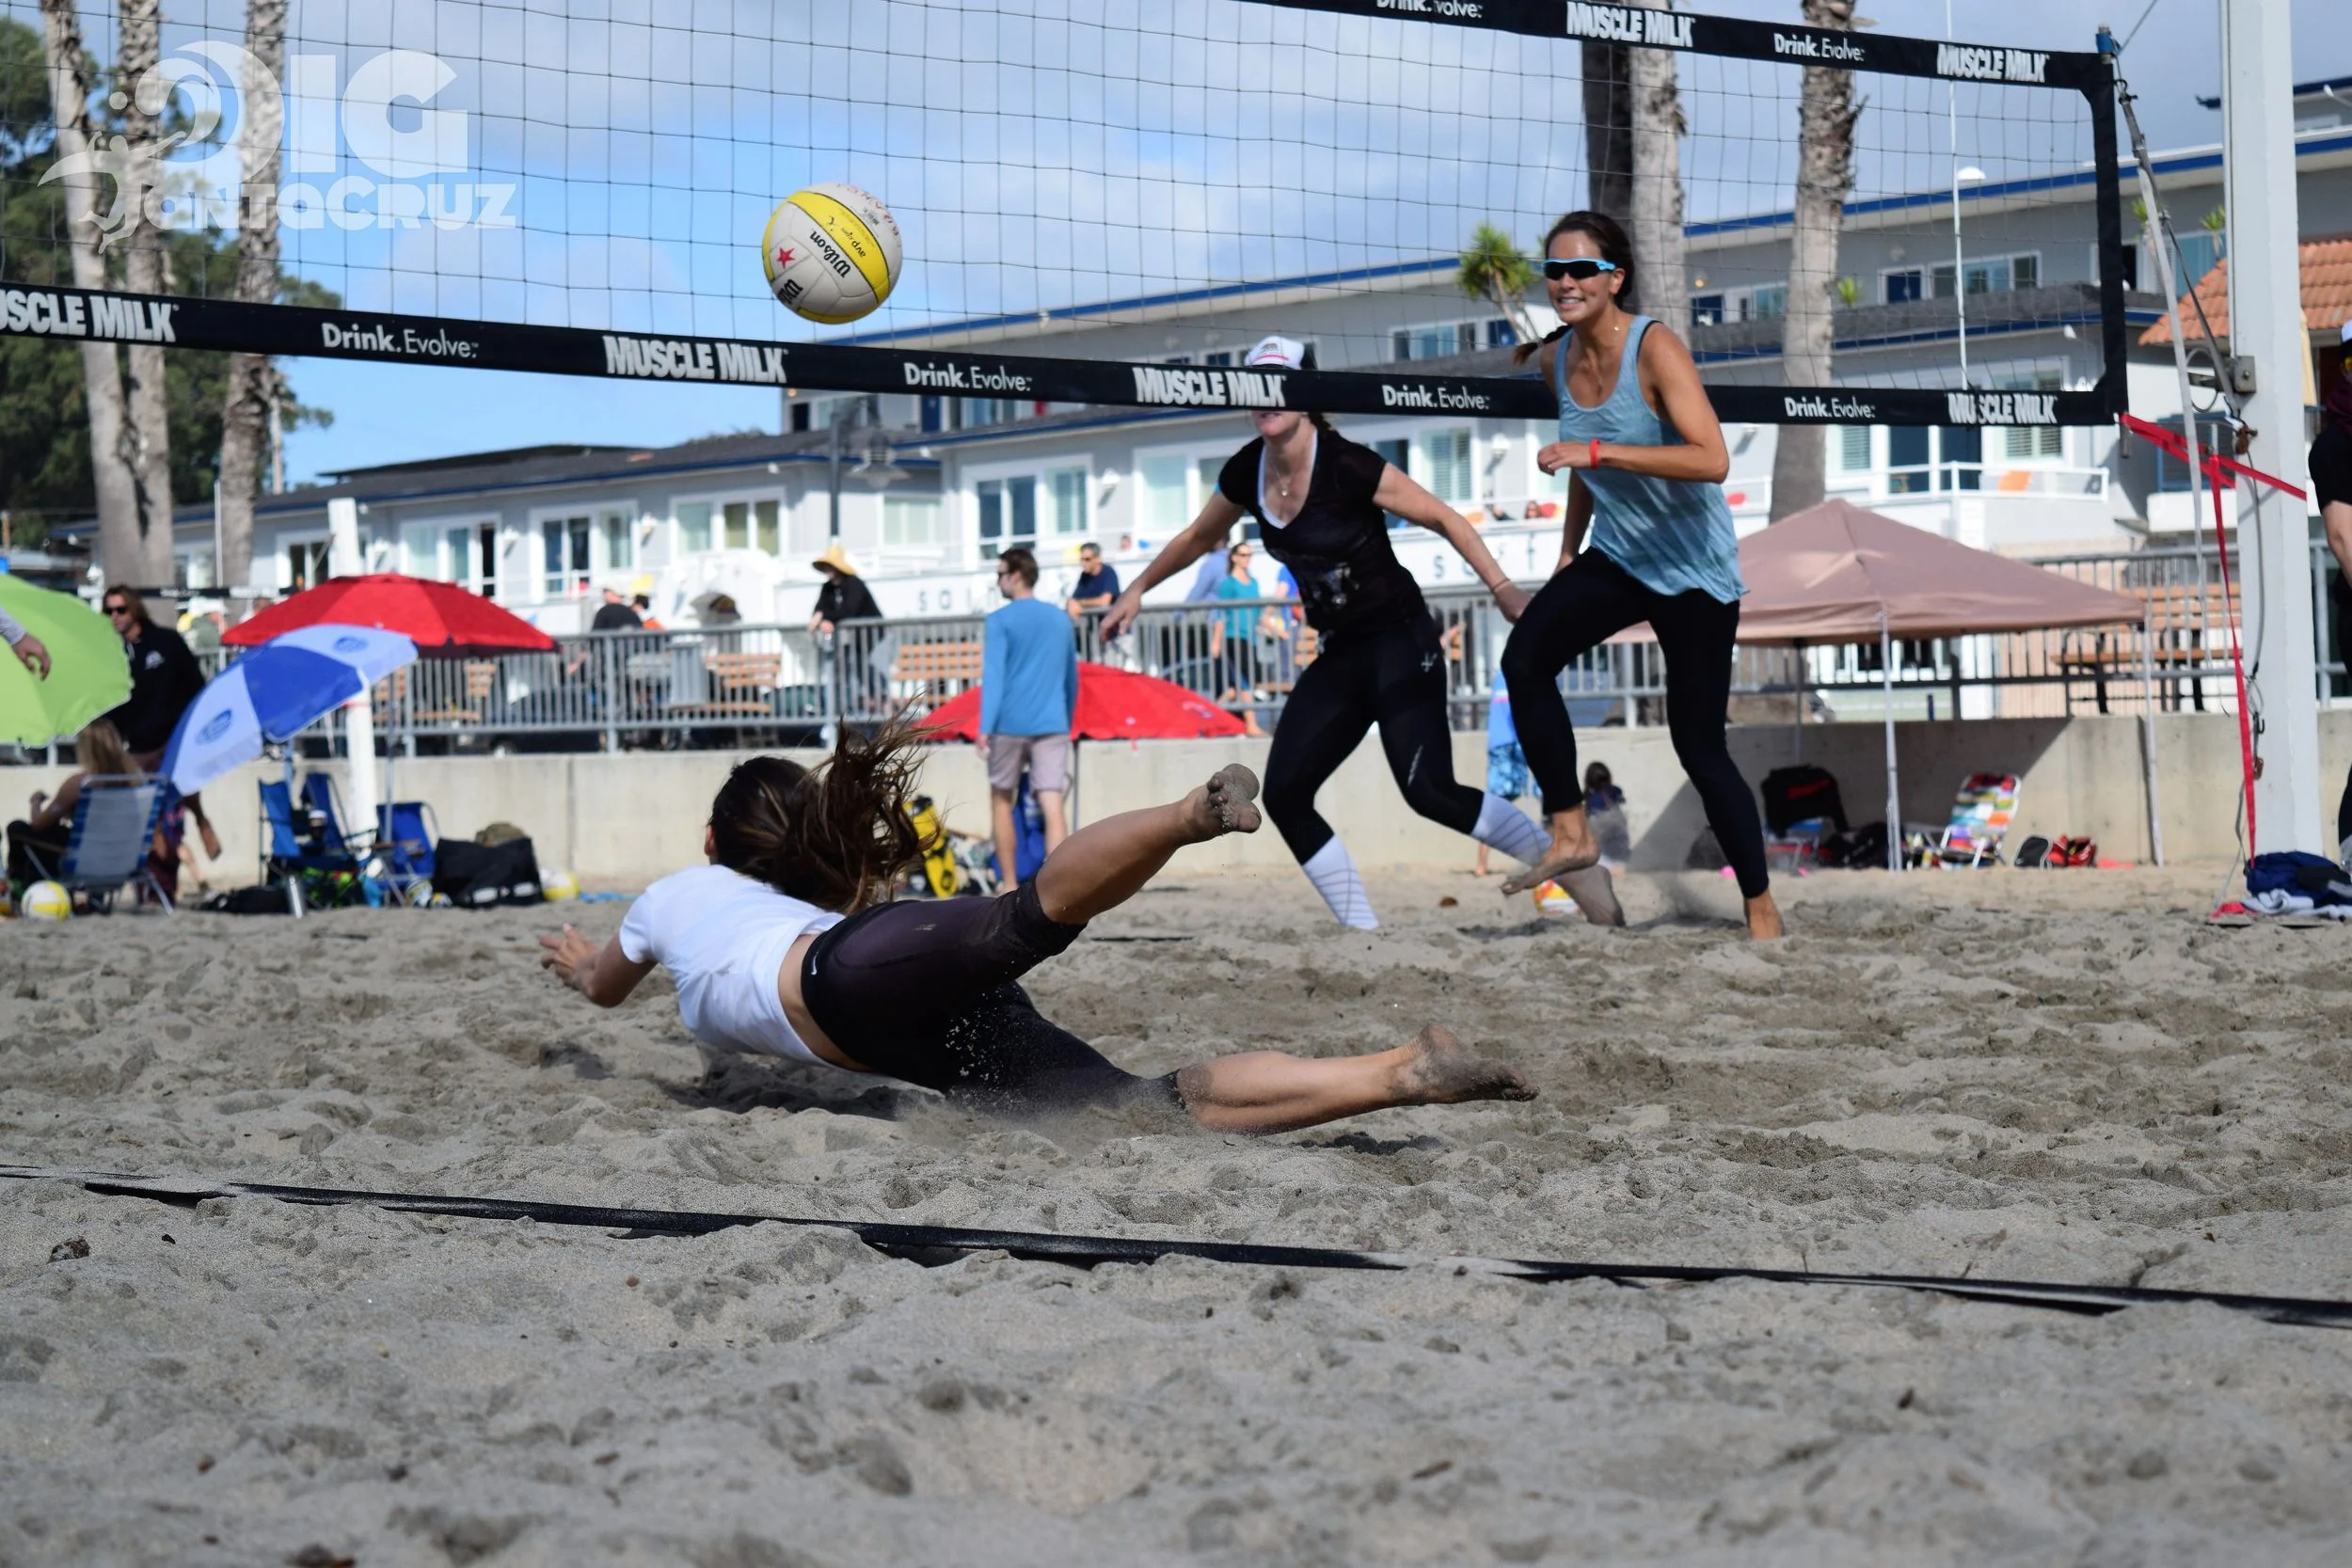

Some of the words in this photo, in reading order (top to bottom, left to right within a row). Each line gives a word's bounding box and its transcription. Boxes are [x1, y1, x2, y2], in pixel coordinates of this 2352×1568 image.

[1566, 1, 1643, 42] MUSCLE
[1645, 9, 1693, 47] MILK
[1773, 33, 1820, 57] Drink.
[1937, 43, 2004, 79] MUSCLE
[2005, 49, 2046, 83] MILK
[809, 230, 851, 278] Wilson
[321, 323, 402, 353] Drink.
[602, 335, 715, 379] MUSCLE
[715, 342, 787, 383] MILK
[903, 362, 969, 388] Drink.
[1132, 367, 1226, 405] MUSCLE
[1225, 371, 1286, 407] MILK
[1381, 384, 1438, 407] Drink.
[1784, 395, 1832, 418] Drink.
[1947, 392, 2014, 424] MUSCLE
[2013, 392, 2058, 424] MILK
